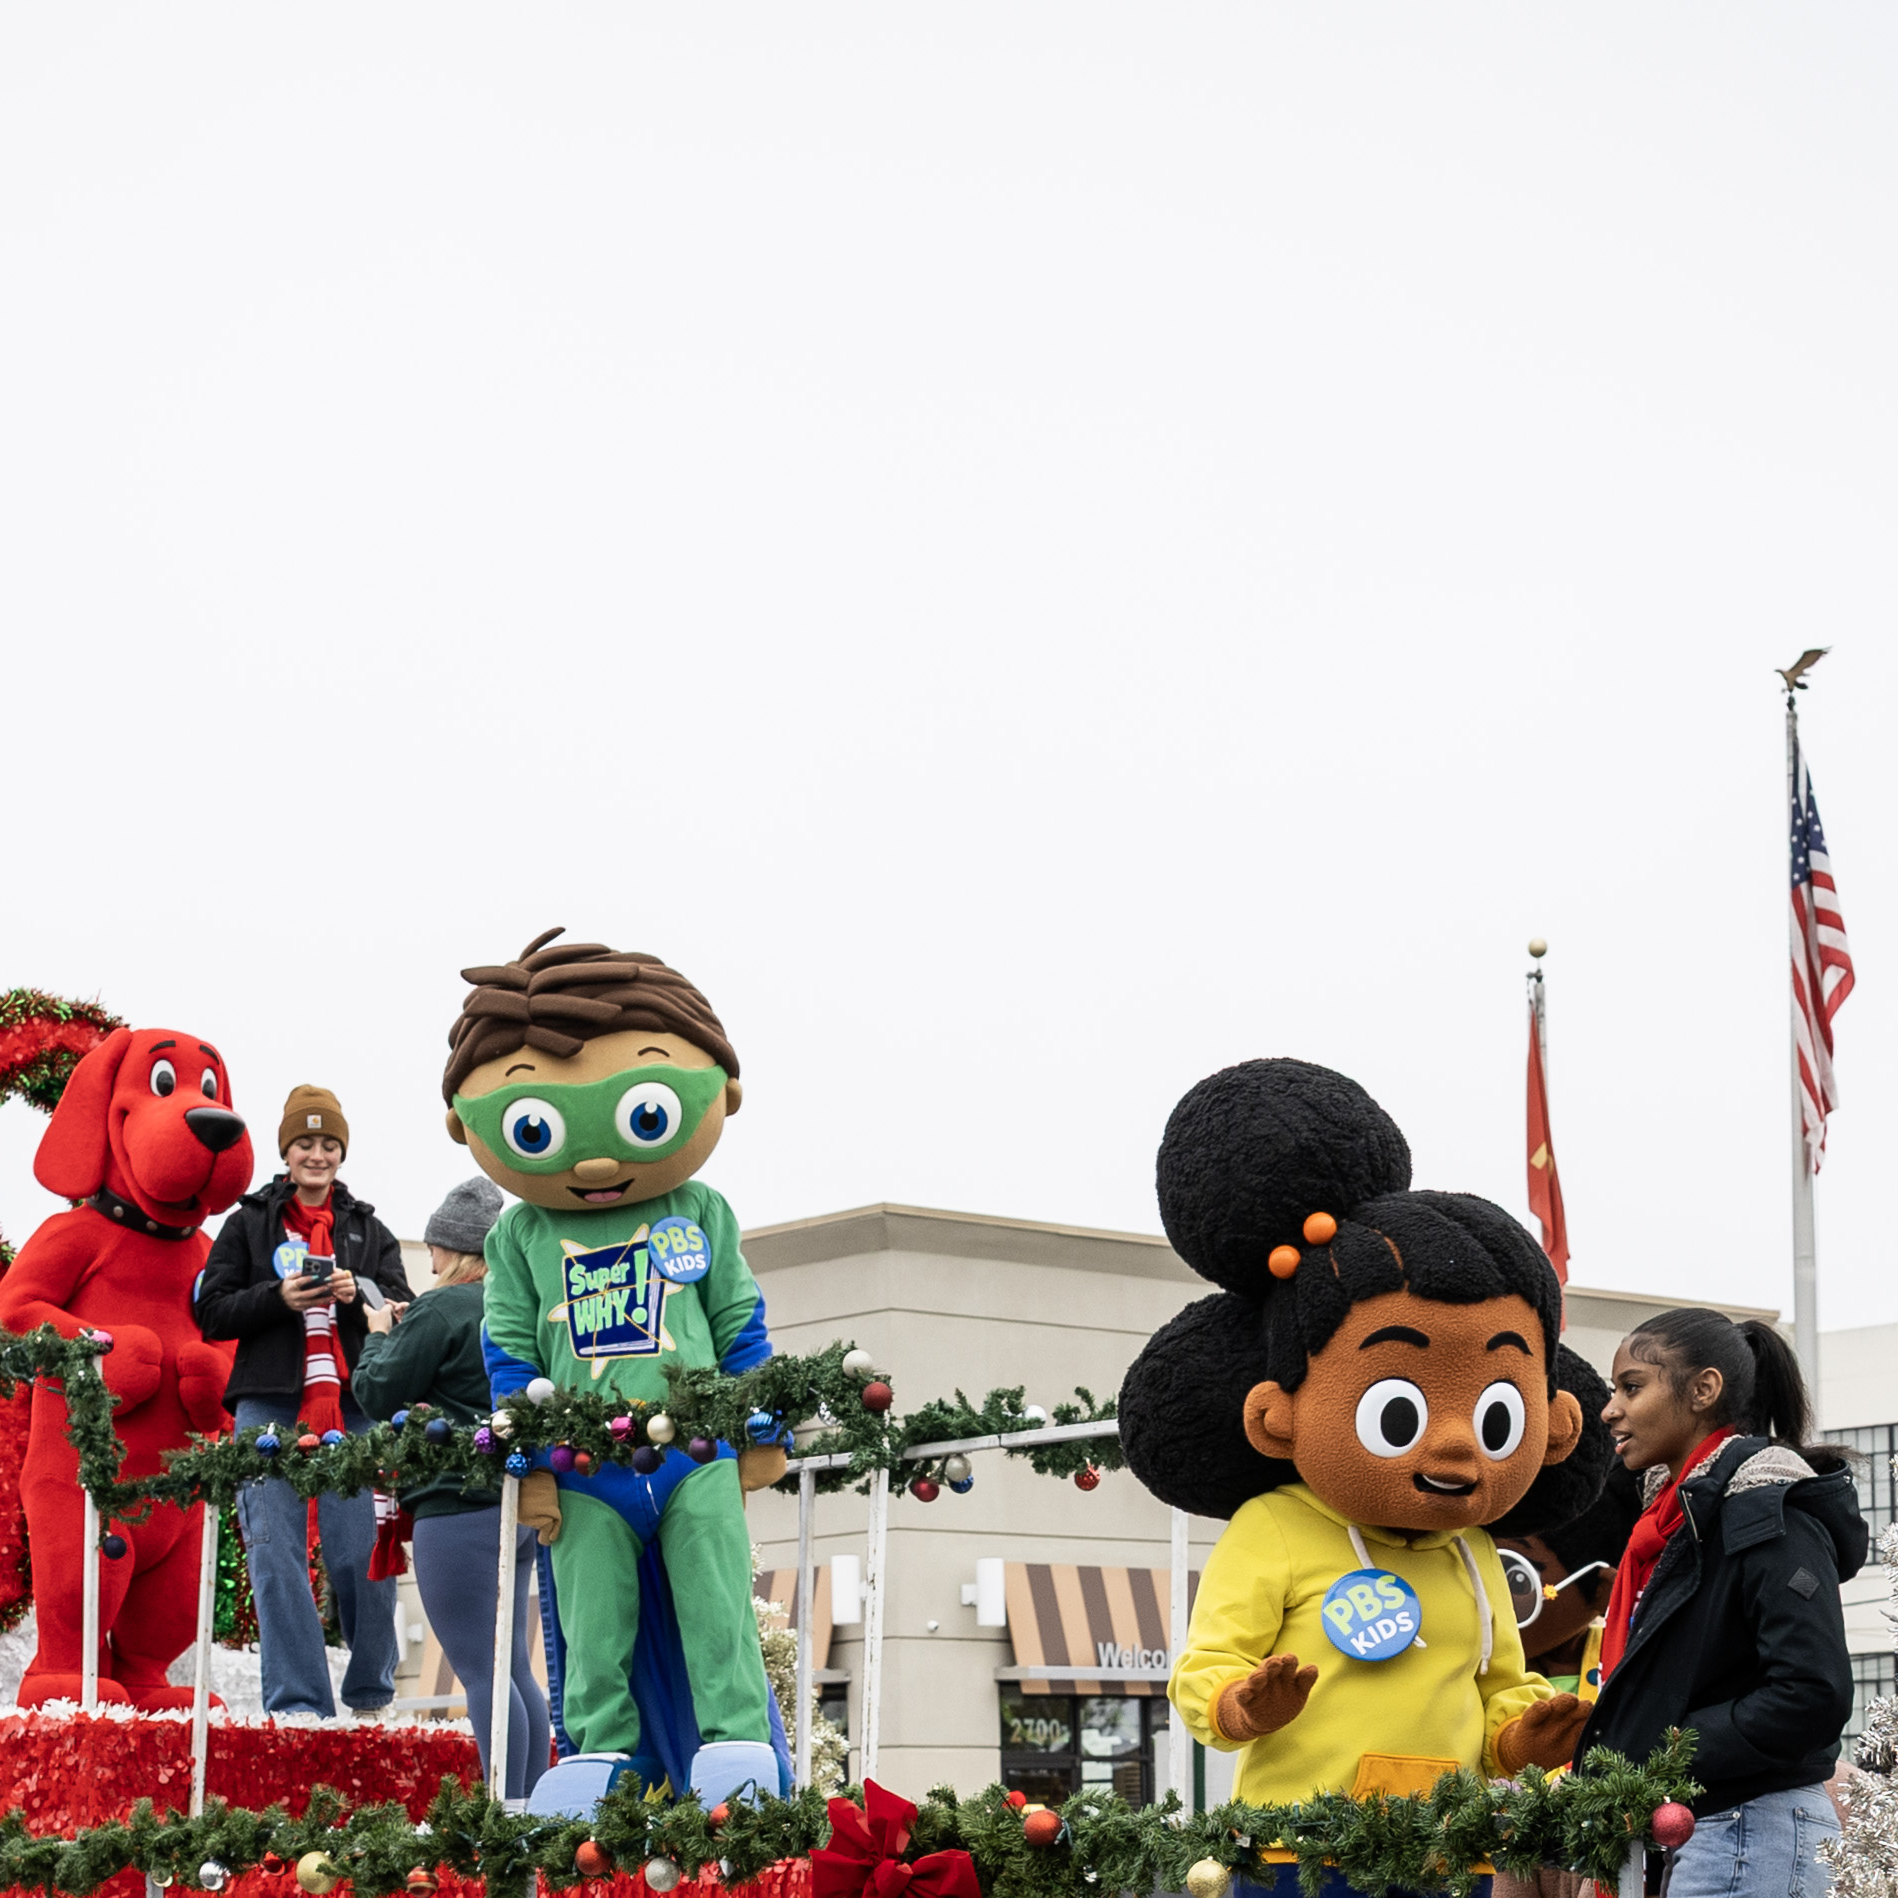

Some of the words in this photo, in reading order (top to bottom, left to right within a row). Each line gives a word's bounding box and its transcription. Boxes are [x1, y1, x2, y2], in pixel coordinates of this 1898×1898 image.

[279, 1246, 309, 1268] PB
[650, 1226, 704, 1259] PBS
[569, 1262, 631, 1296] Super
[664, 1254, 707, 1276] KIDS
[1323, 1575, 1406, 1636] PBS
[1350, 1611, 1414, 1656] KIDS
[1098, 1642, 1171, 1669] Welco
[1010, 1718, 1063, 1744] 2700
